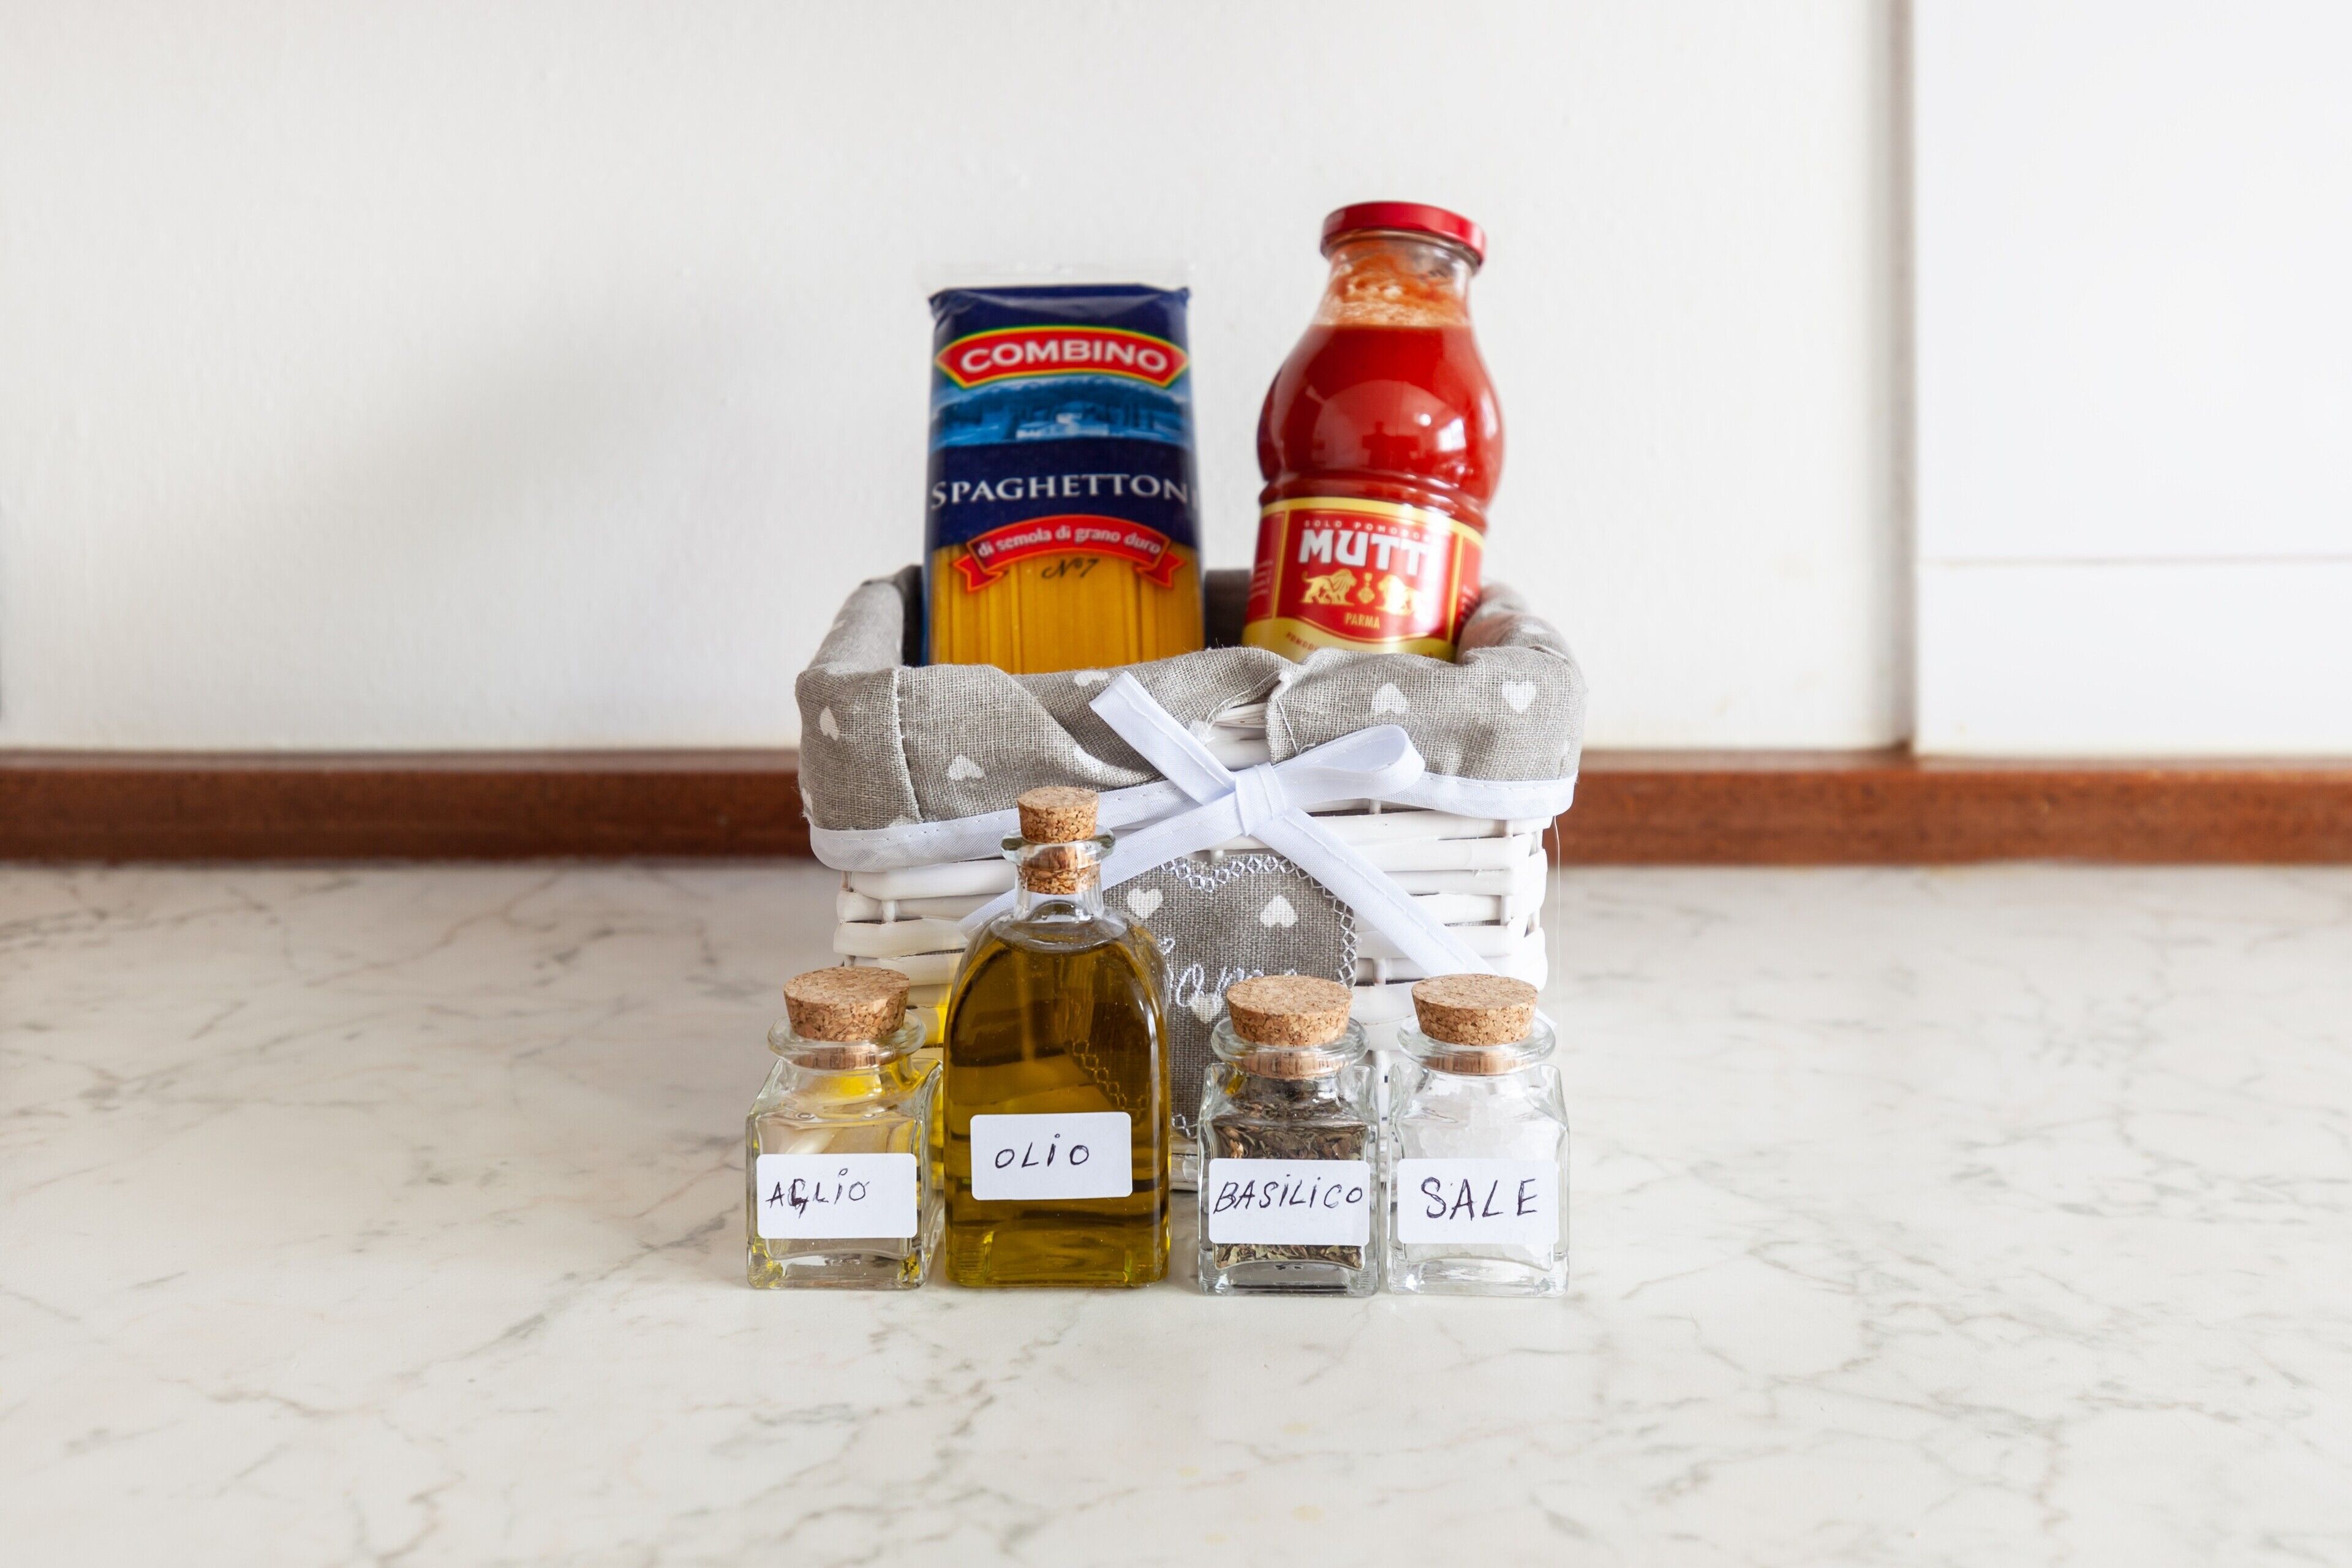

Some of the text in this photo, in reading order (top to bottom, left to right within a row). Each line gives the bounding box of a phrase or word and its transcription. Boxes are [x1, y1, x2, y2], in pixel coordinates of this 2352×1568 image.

[960, 339, 1167, 373] COMBINO
[978, 524, 1161, 557] di semola di grano duro
[1304, 519, 1432, 541] SOLO POMODOR
[1298, 529, 1438, 576] MUTT
[1345, 612, 1381, 630] PARMA
[1421, 1177, 1537, 1221] SALE
